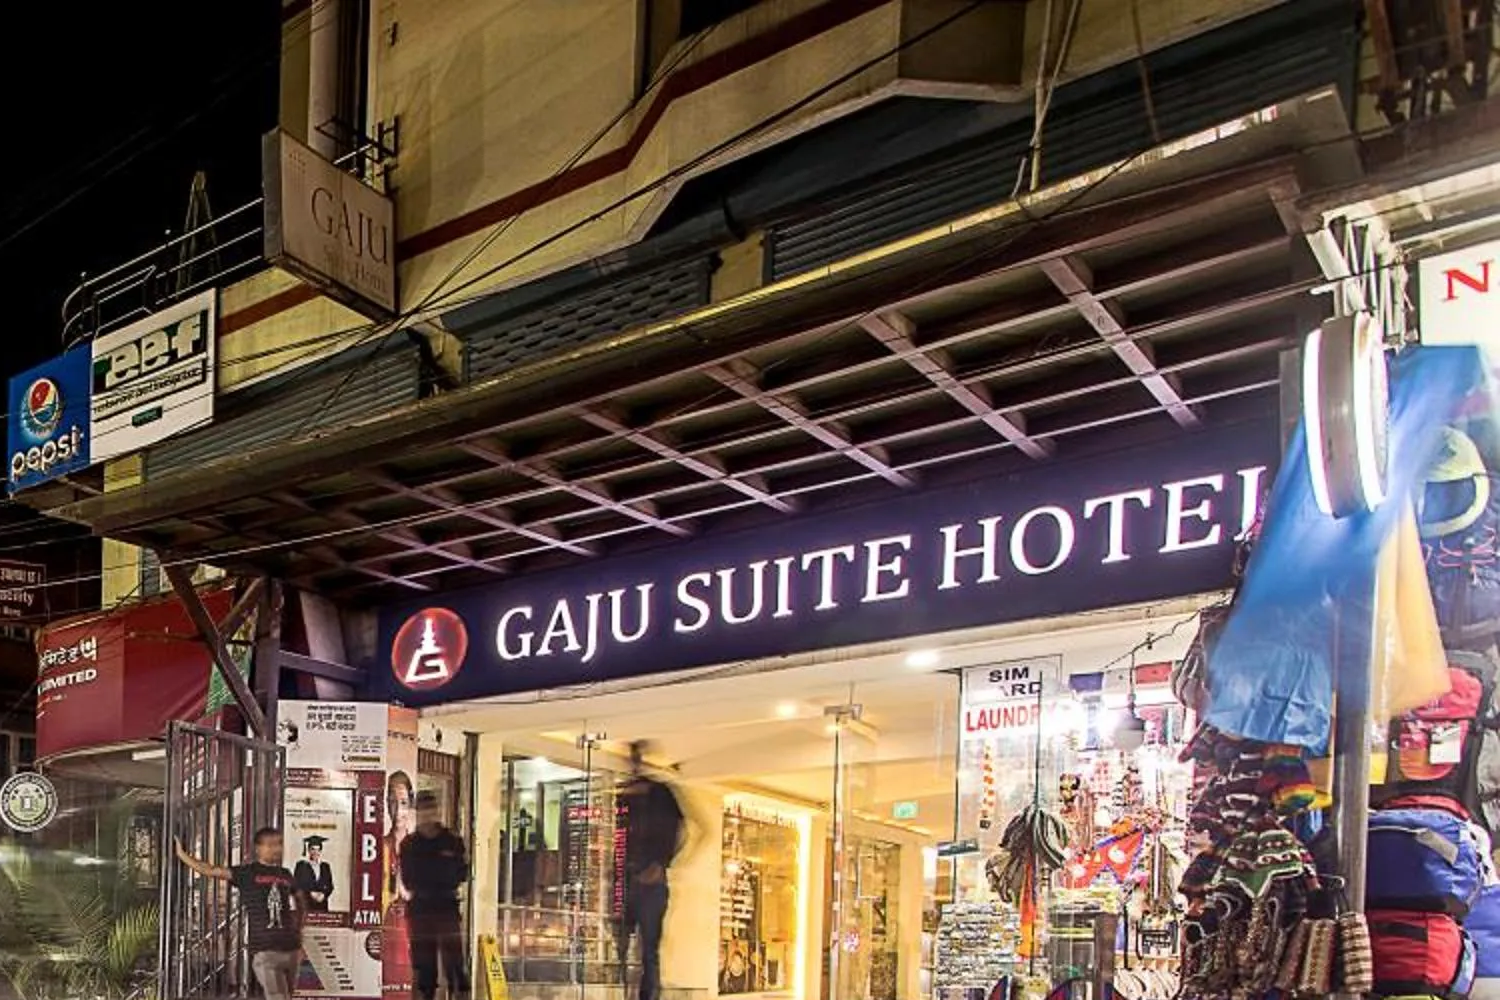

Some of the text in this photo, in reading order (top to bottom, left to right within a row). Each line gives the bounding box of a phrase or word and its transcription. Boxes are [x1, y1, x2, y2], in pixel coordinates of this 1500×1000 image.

[312, 187, 387, 265] GAJU
[105, 313, 202, 389] reef
[11, 424, 81, 481] pepsi
[495, 583, 653, 663] GAJU
[674, 534, 912, 631] SUITE
[988, 667, 1029, 683] SIM
[966, 704, 1043, 732] LAUNDR
[353, 911, 381, 925] ATM
